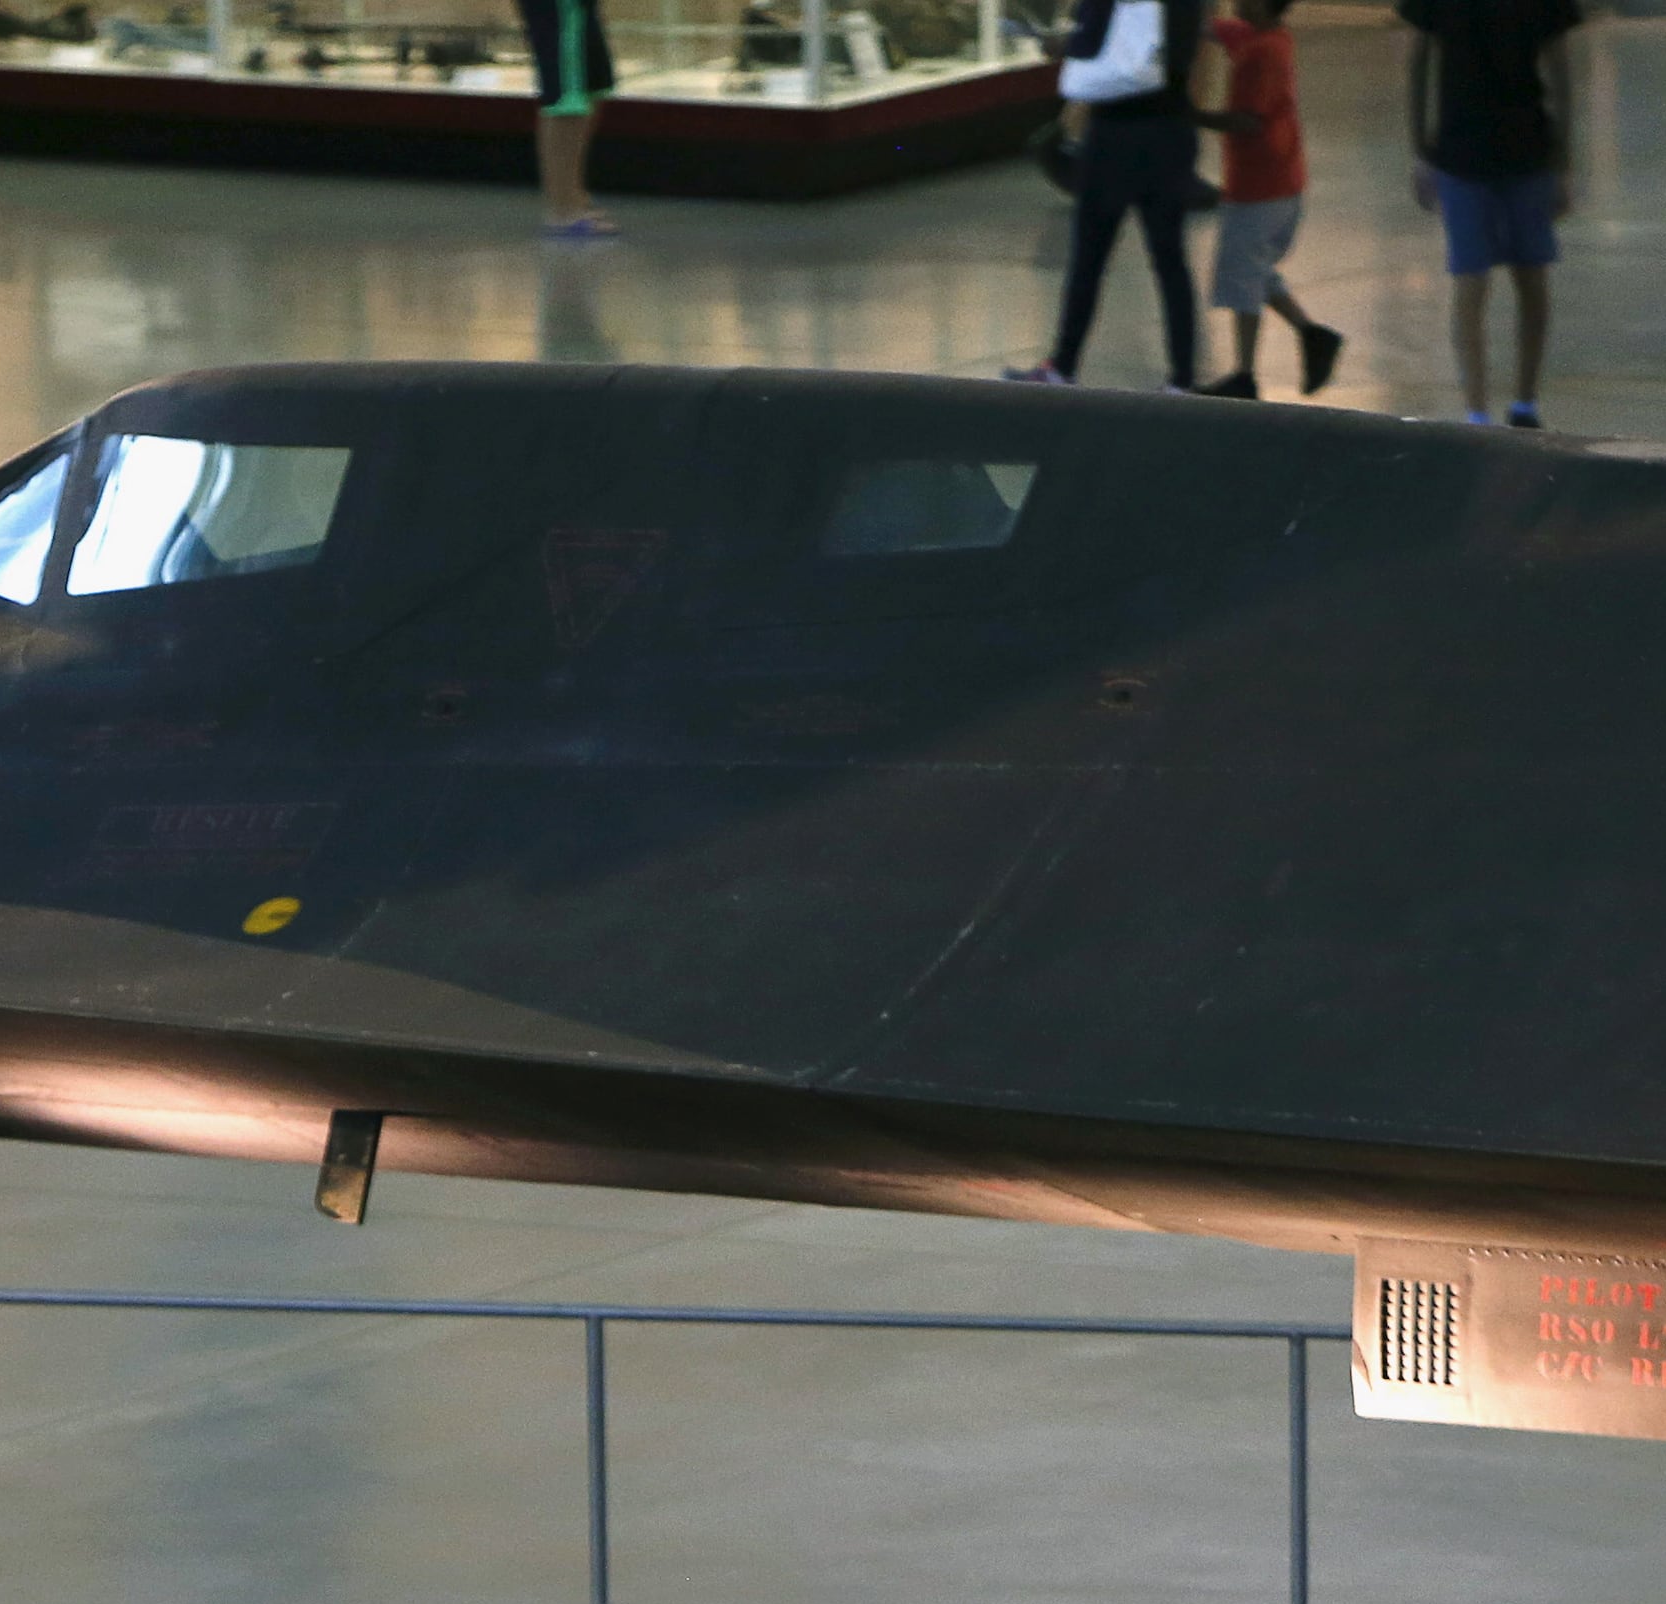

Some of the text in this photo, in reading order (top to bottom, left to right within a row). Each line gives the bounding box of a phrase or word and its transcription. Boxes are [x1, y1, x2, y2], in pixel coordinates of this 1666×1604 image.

[1538, 1274, 1662, 1312] PILOT
[1538, 1312, 1616, 1344] RSO
[1536, 1350, 1604, 1382] C/C
